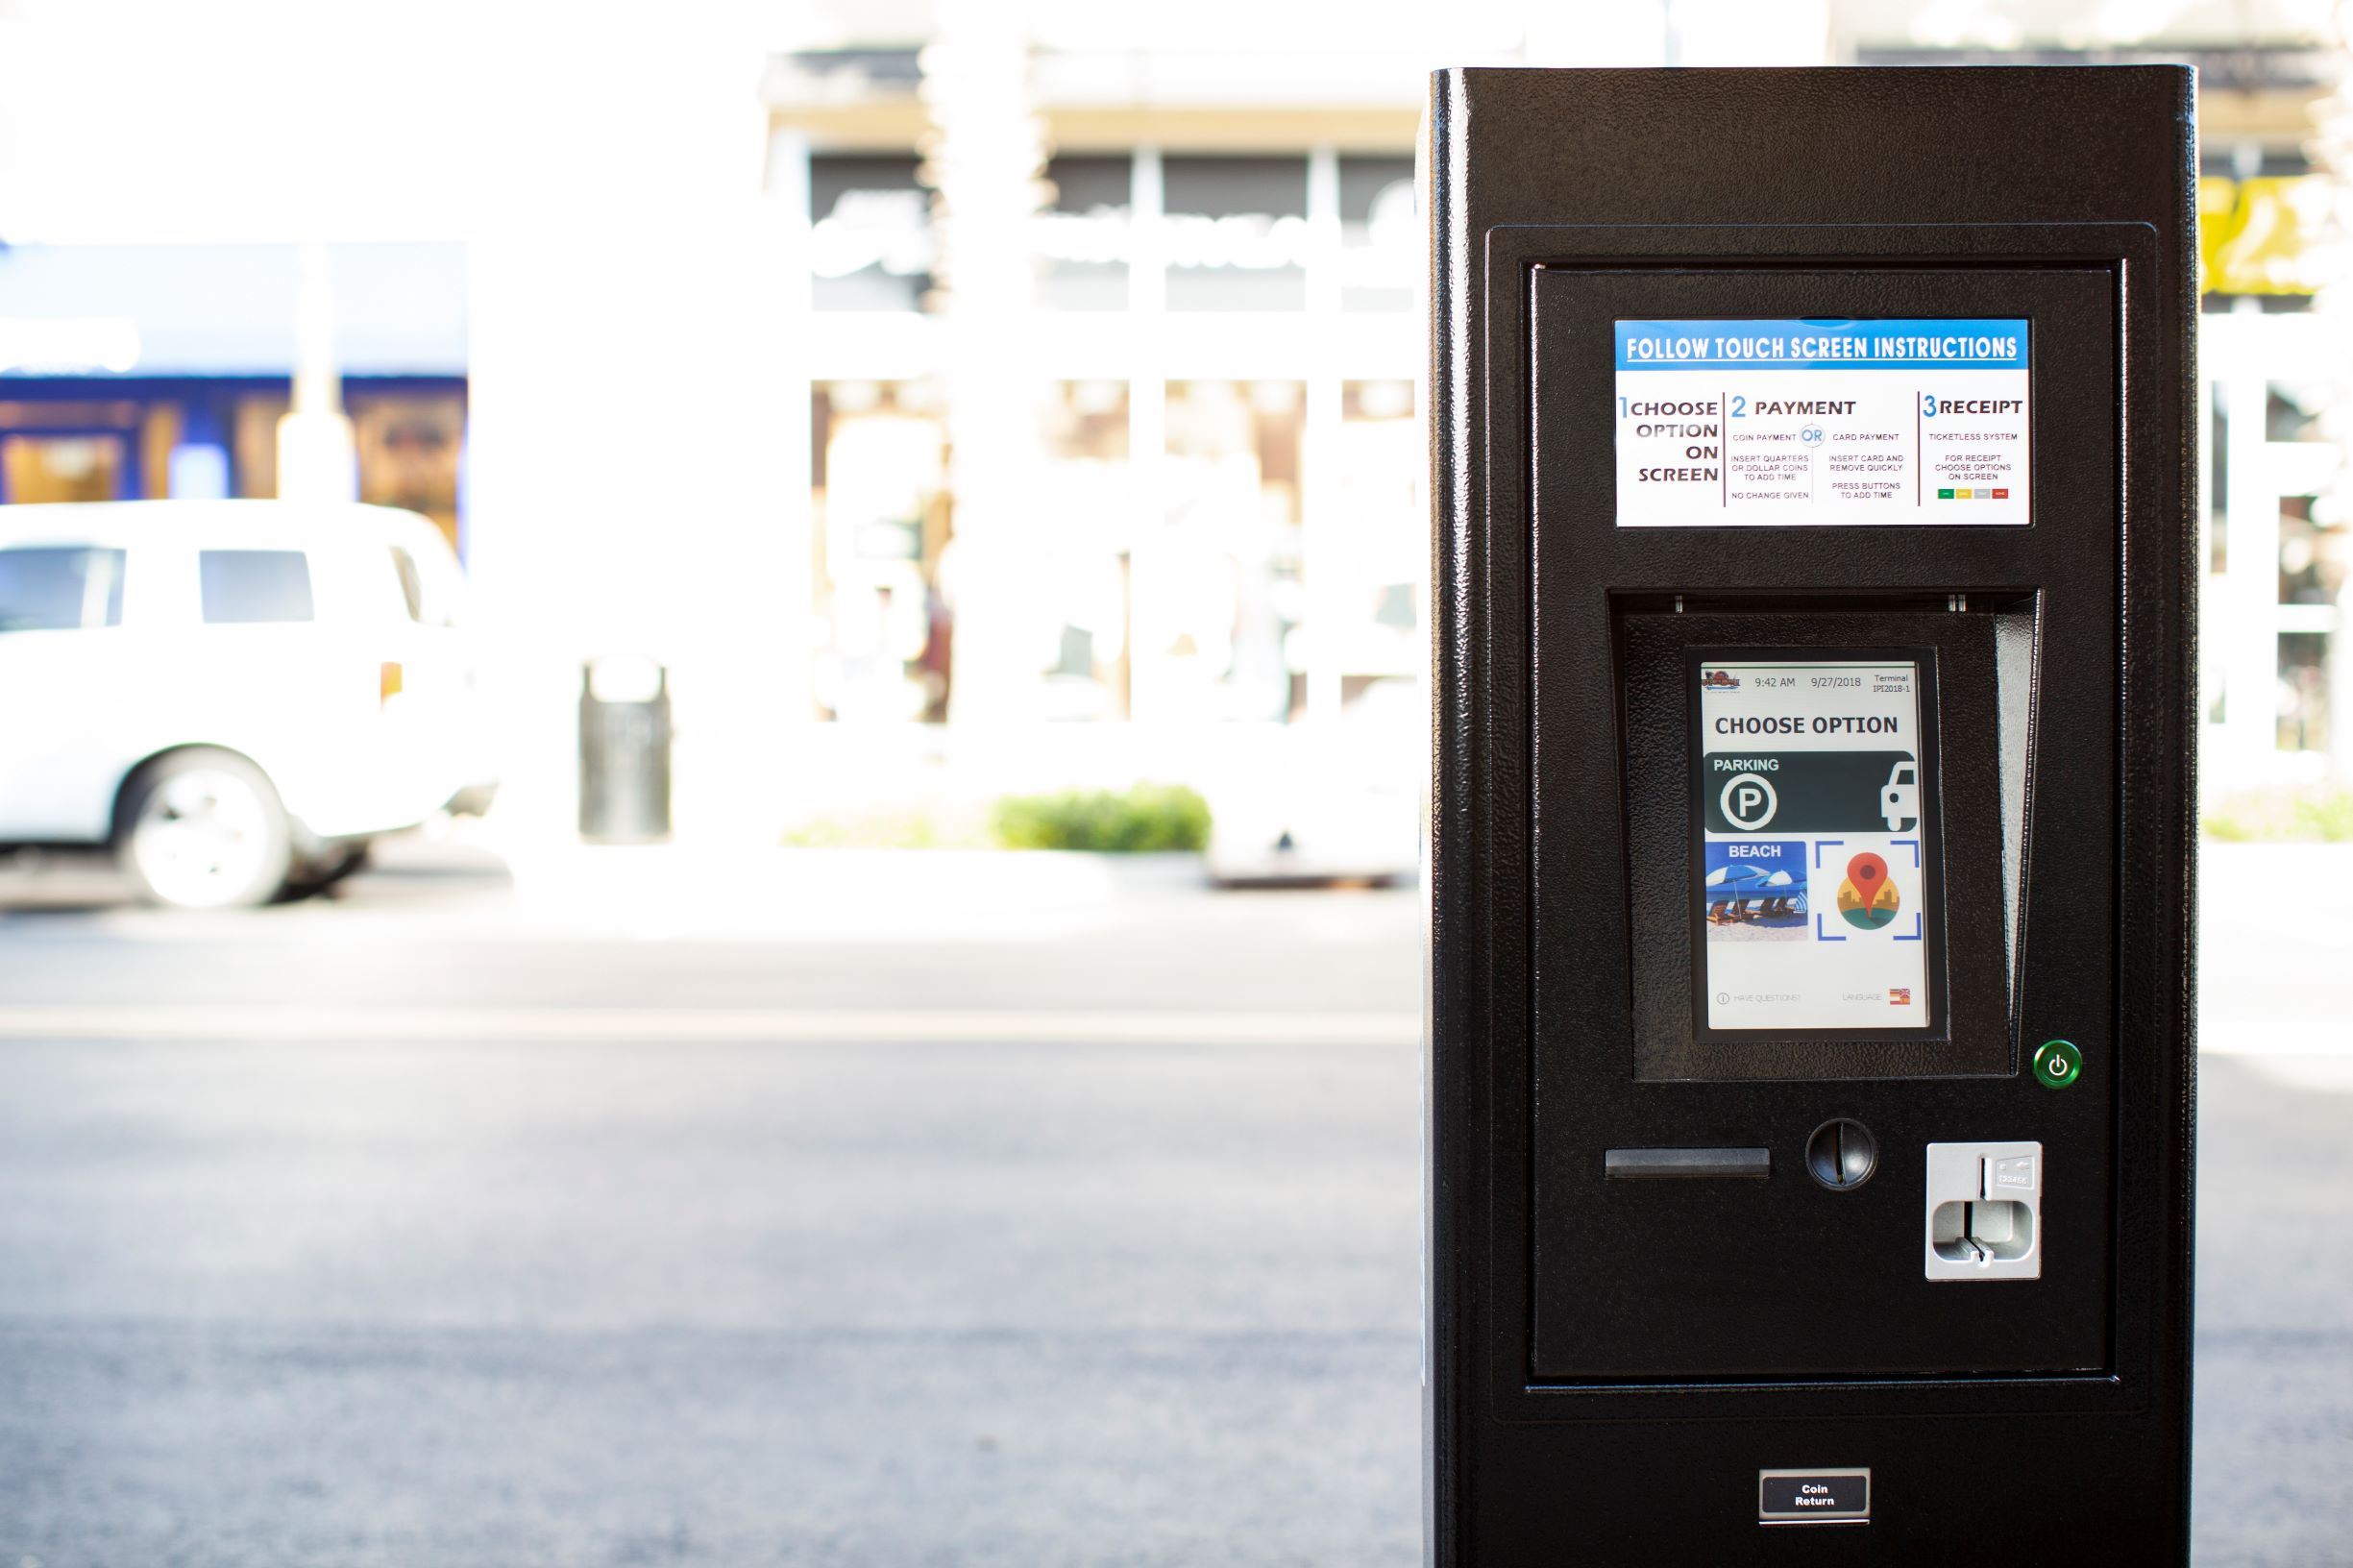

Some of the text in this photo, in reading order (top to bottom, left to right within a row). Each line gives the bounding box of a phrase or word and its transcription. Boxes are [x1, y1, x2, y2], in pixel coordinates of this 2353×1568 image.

[1627, 337, 2017, 359] FOLLOW TOUCH SCREEN INSTRUCTIONS
[1619, 397, 1718, 418] 1 CHOOSE
[1731, 396, 1856, 417] 2 PAYMENT
[1923, 395, 2022, 417] 3 RECEIPT
[1636, 424, 1718, 438] OPTION
[1802, 429, 1822, 441] OR
[1686, 446, 1718, 459] ON
[1639, 468, 1718, 481] SCREEN
[1754, 677, 1796, 687] 9:42 AM
[1811, 677, 1861, 688] 9/27/2018
[1715, 717, 1898, 734] CHOOSE OPTION
[1714, 759, 1779, 772] PARKING
[1739, 788, 1762, 817] P
[1729, 845, 1781, 857] BEACH
[1802, 1484, 1827, 1494] Coin
[1795, 1497, 1834, 1506] Return
